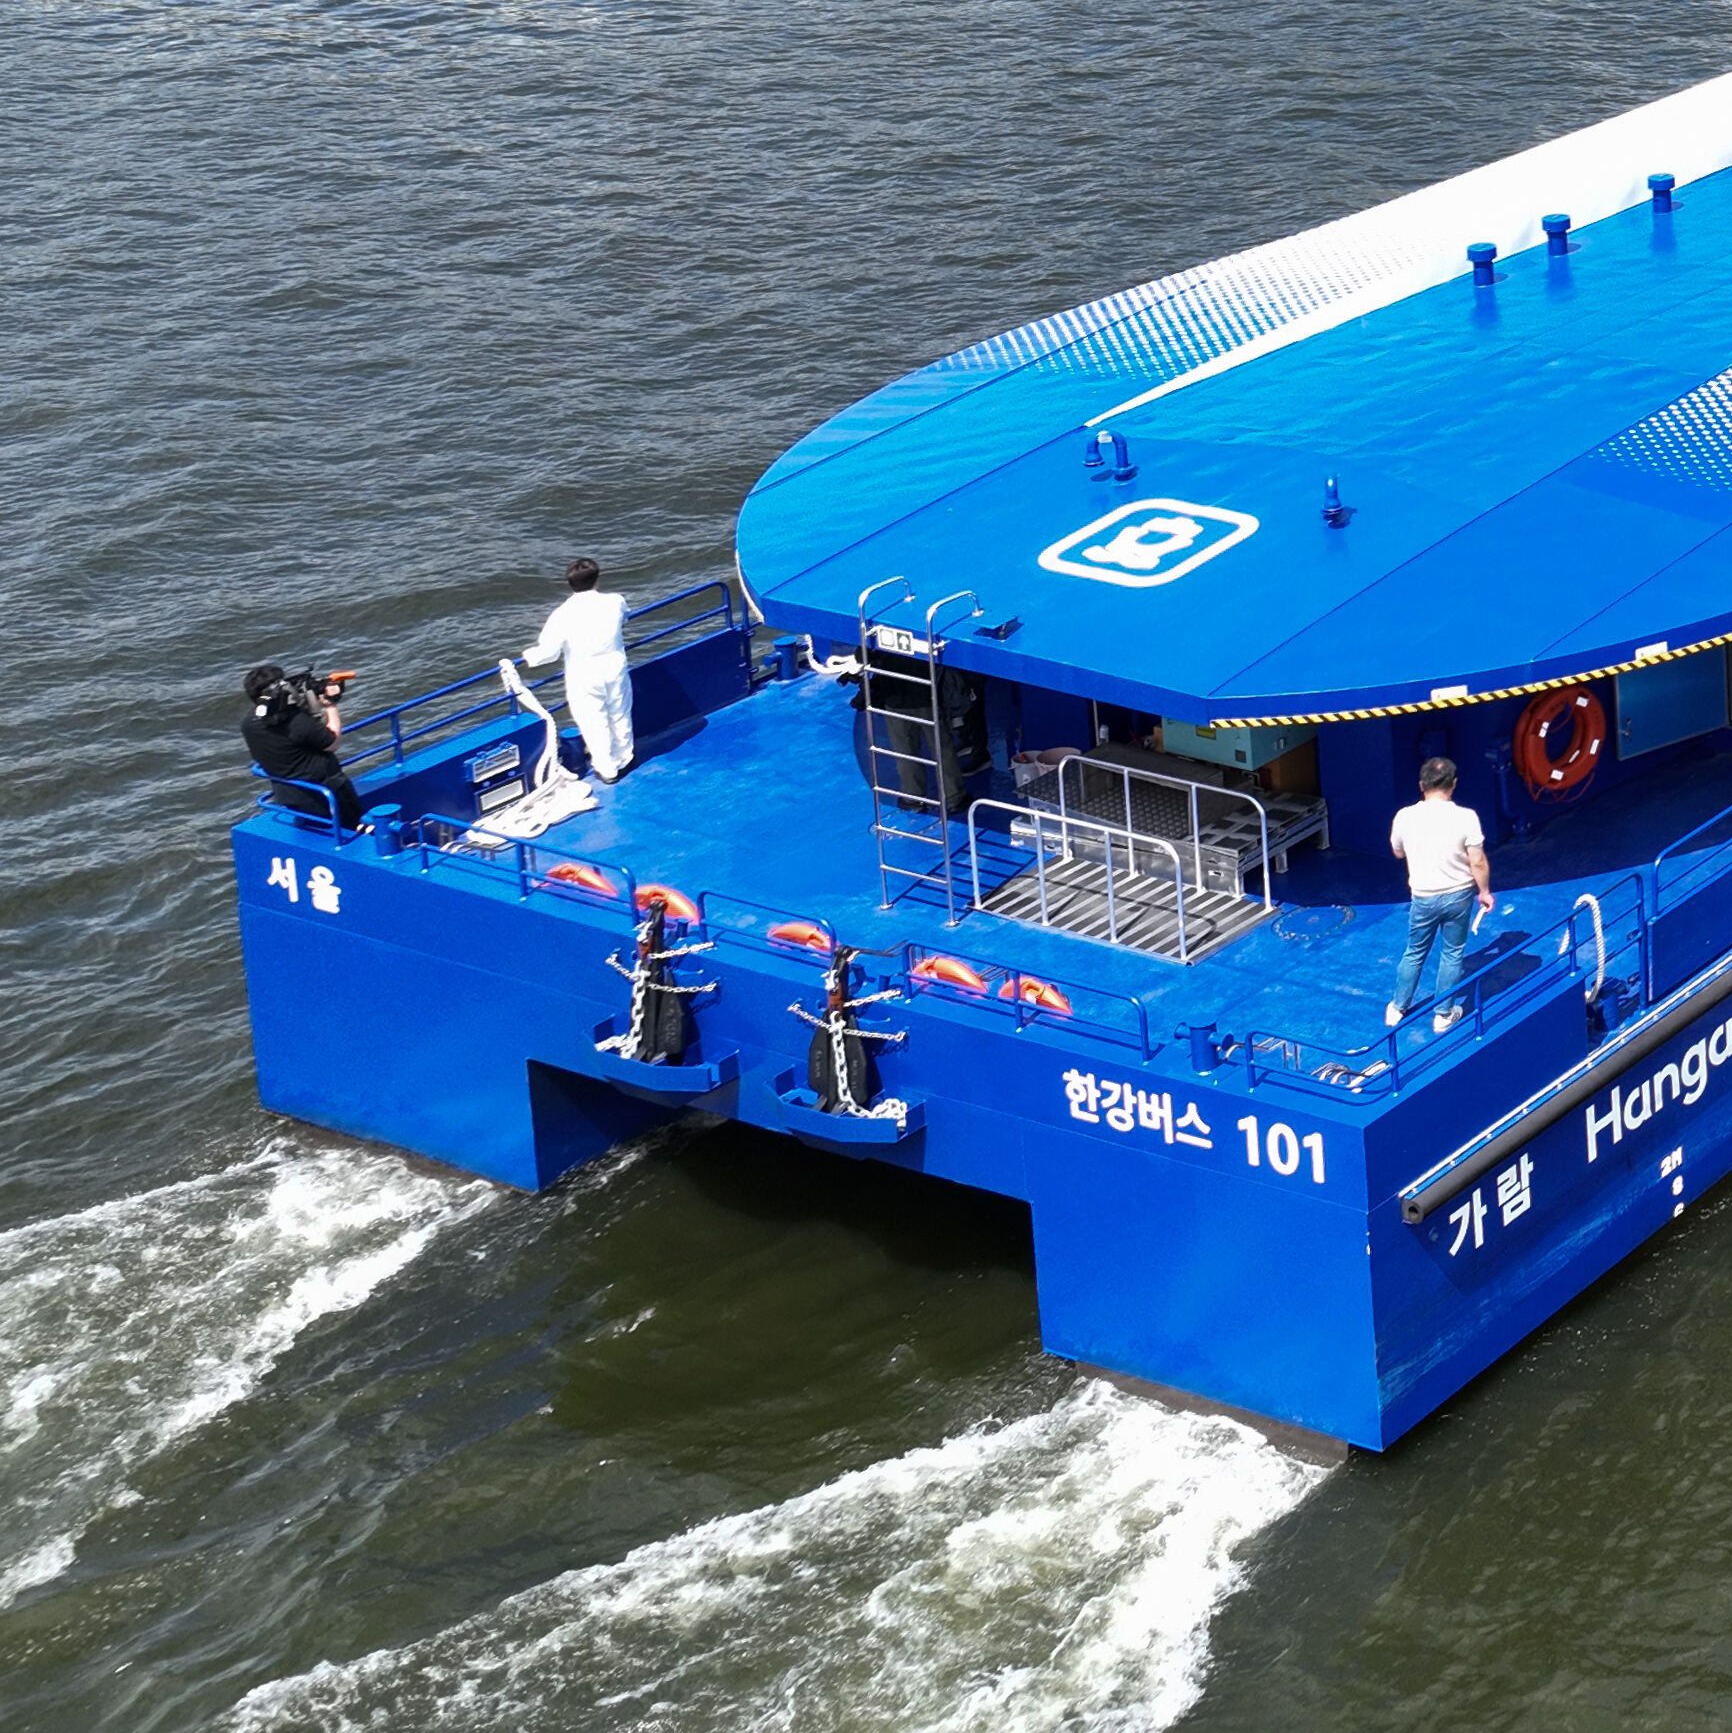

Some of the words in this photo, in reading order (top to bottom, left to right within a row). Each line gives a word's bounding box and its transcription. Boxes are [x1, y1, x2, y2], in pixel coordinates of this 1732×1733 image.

[267, 856, 342, 914] 서울
[1062, 1068, 1213, 1149] 한강버스
[1237, 1115, 1325, 1184] 101
[1661, 1146, 1683, 1178] 2M
[1672, 1175, 1684, 1196] 8
[1448, 1152, 1535, 1258] 가람
